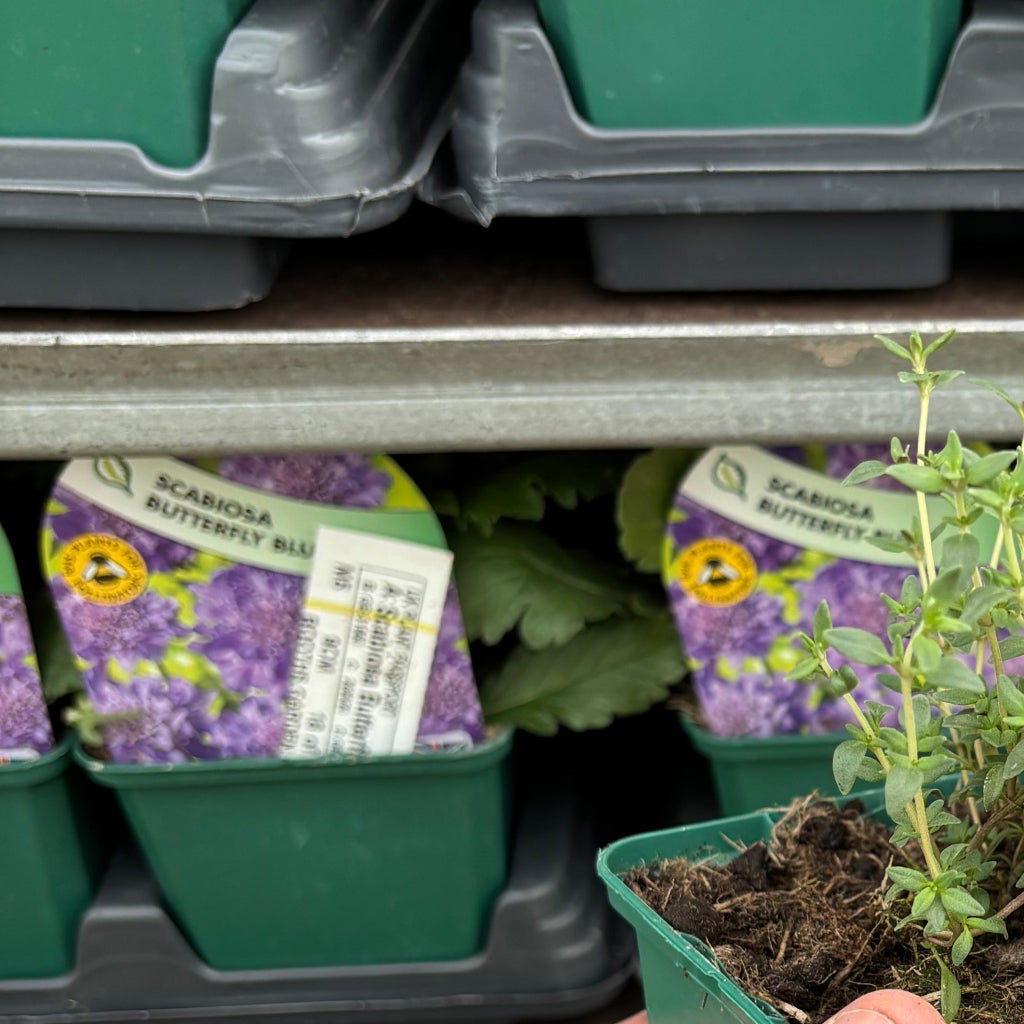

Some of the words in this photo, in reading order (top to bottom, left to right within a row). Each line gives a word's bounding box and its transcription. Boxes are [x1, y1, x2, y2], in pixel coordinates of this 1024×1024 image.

[155, 473, 273, 528] SCABIOSA
[758, 498, 868, 542] BUTTERFLY
[768, 477, 874, 520] SCABIOSA
[145, 494, 262, 548] BUTTERFLY
[273, 537, 314, 559] BLU
